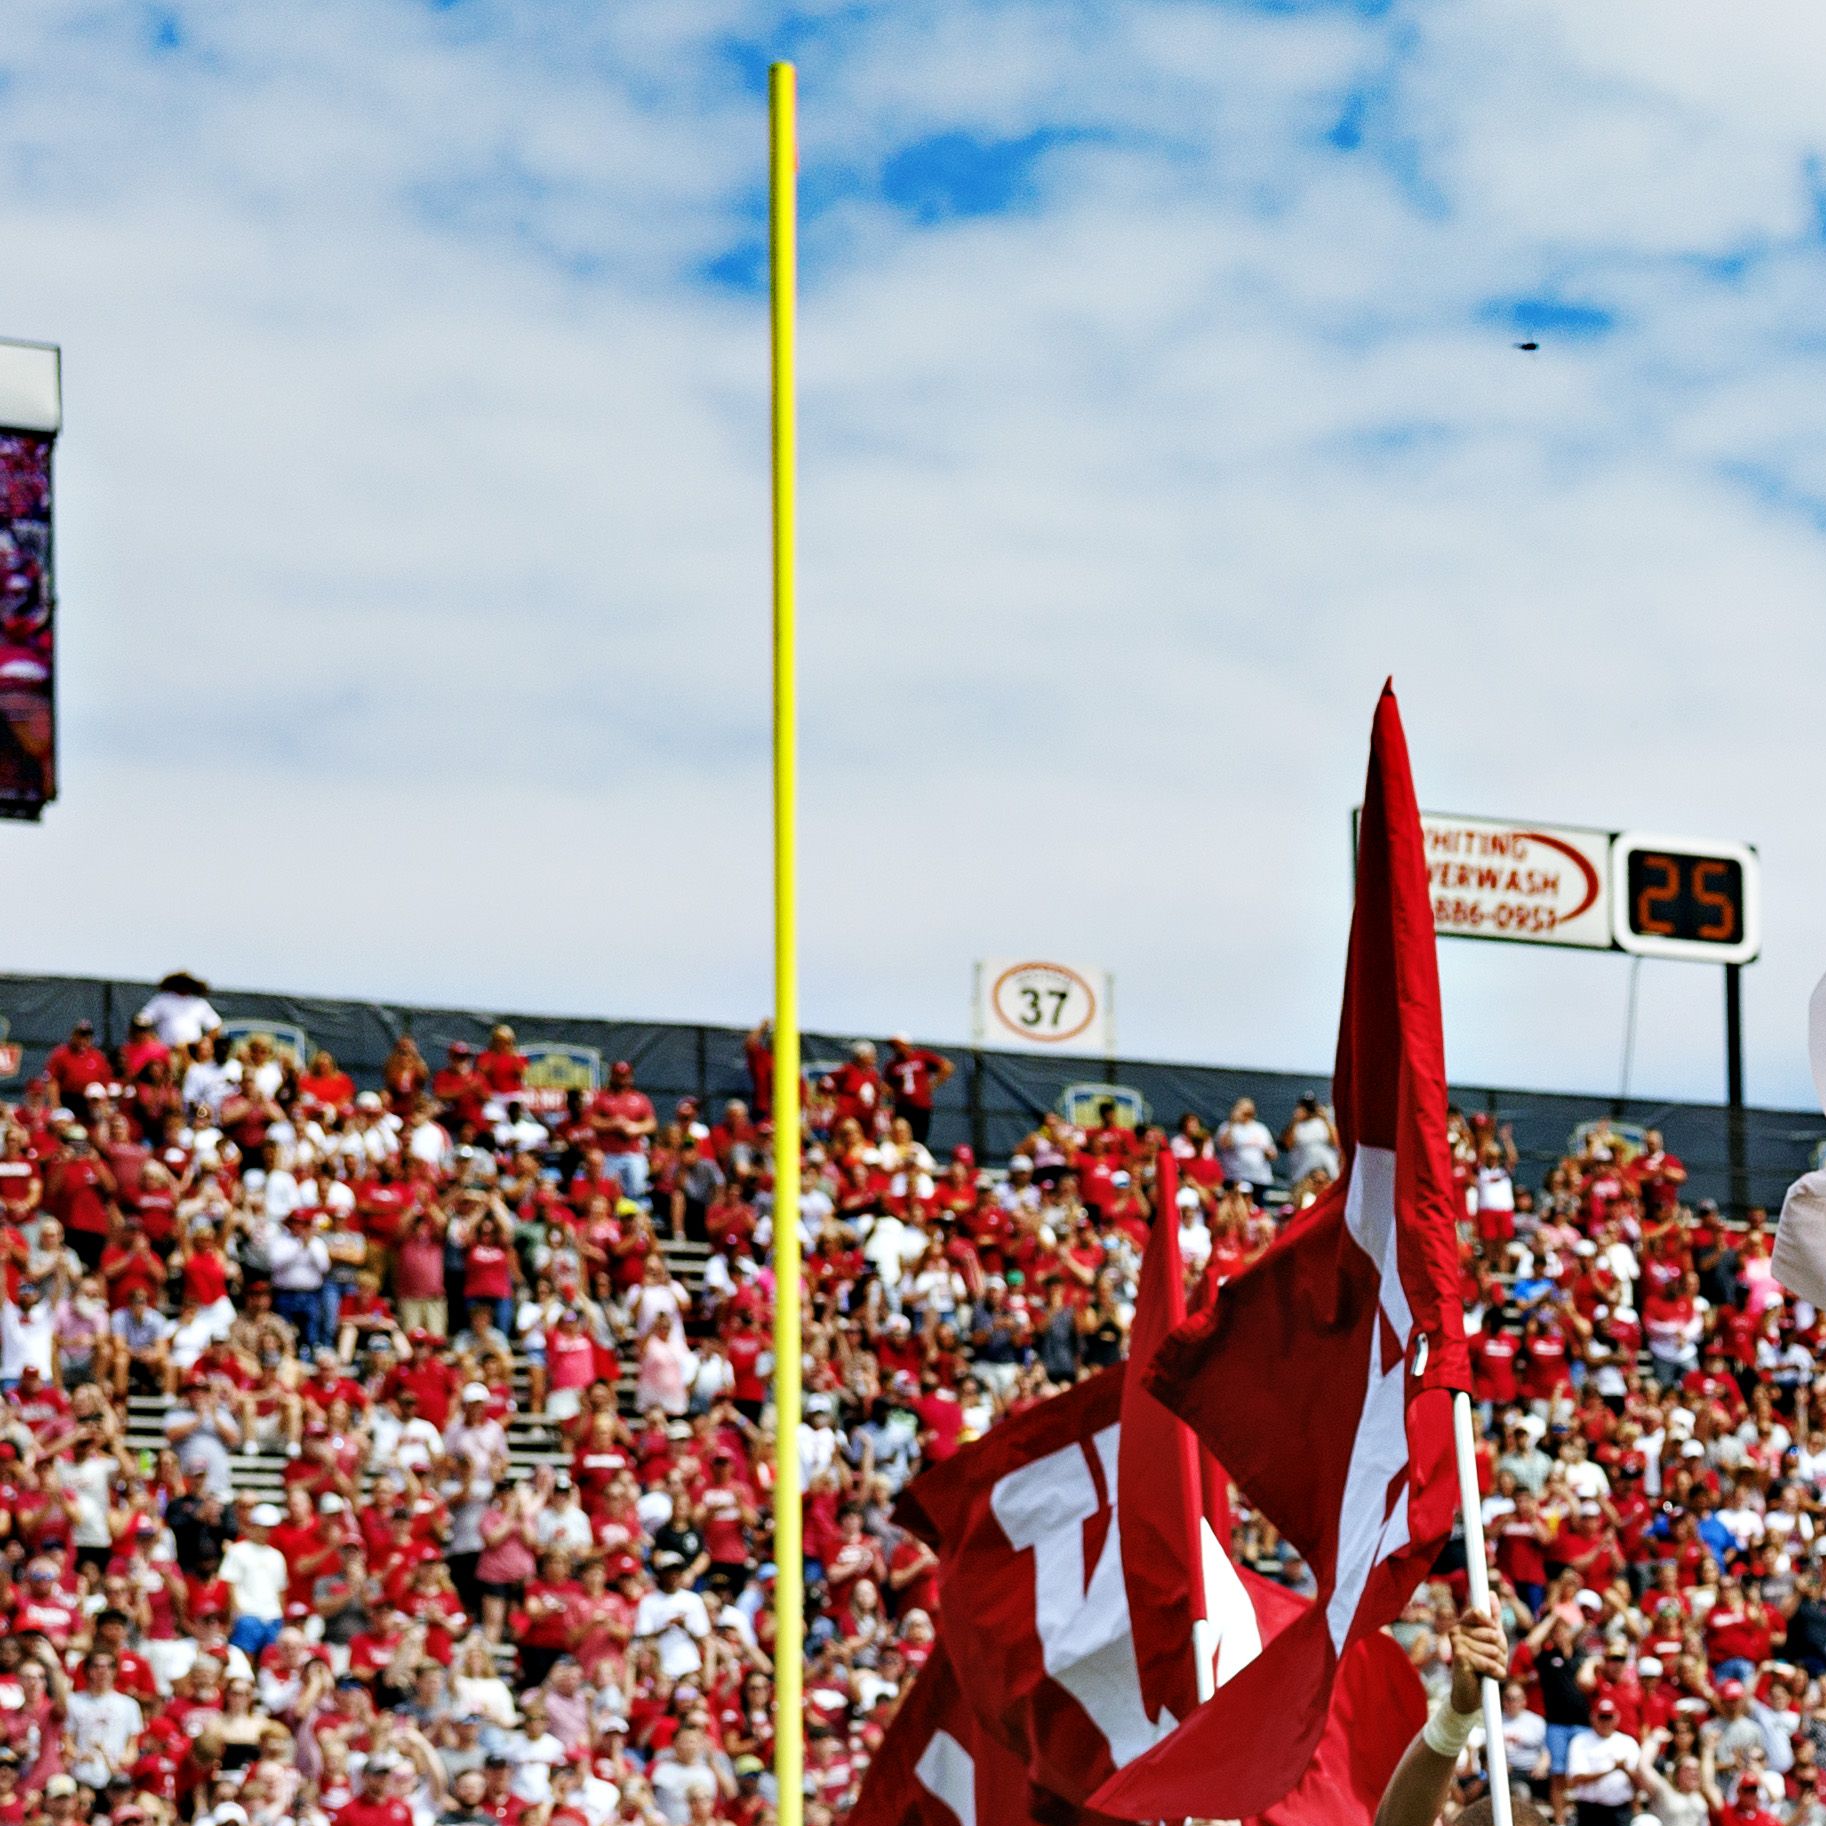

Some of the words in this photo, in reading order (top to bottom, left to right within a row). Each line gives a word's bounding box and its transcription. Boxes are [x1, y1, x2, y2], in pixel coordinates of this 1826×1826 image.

[1424, 829, 1528, 861] HITING
[1637, 855, 1735, 941] 25
[1020, 987, 1067, 1027] 37
